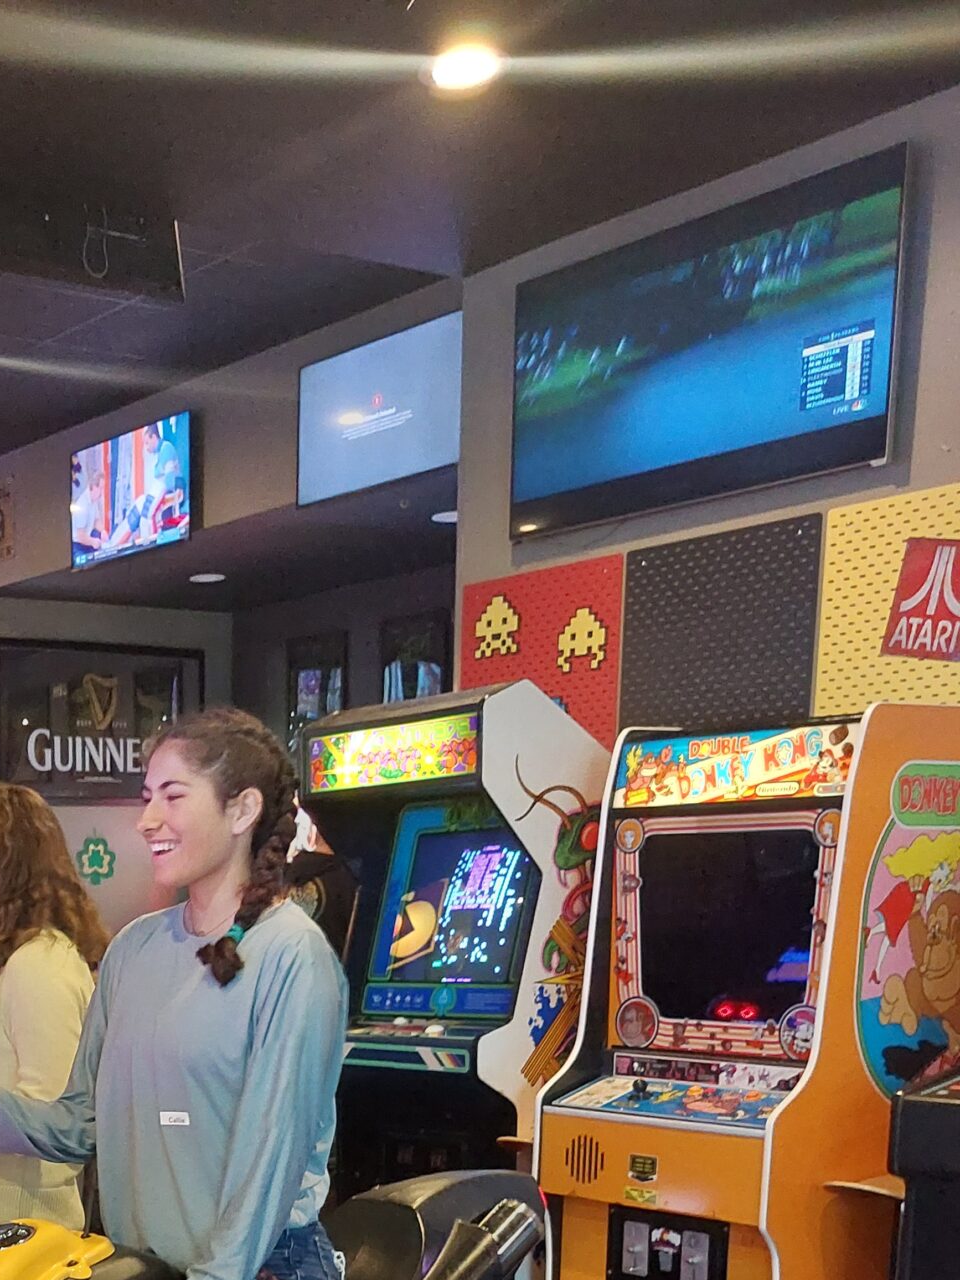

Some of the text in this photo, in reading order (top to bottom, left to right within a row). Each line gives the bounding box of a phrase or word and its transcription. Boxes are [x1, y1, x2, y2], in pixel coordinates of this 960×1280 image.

[888, 616, 960, 653] ATARI
[27, 727, 147, 774] GUINNE
[677, 727, 824, 800] DONKEY KONG
[688, 735, 751, 760] DOUBLE
